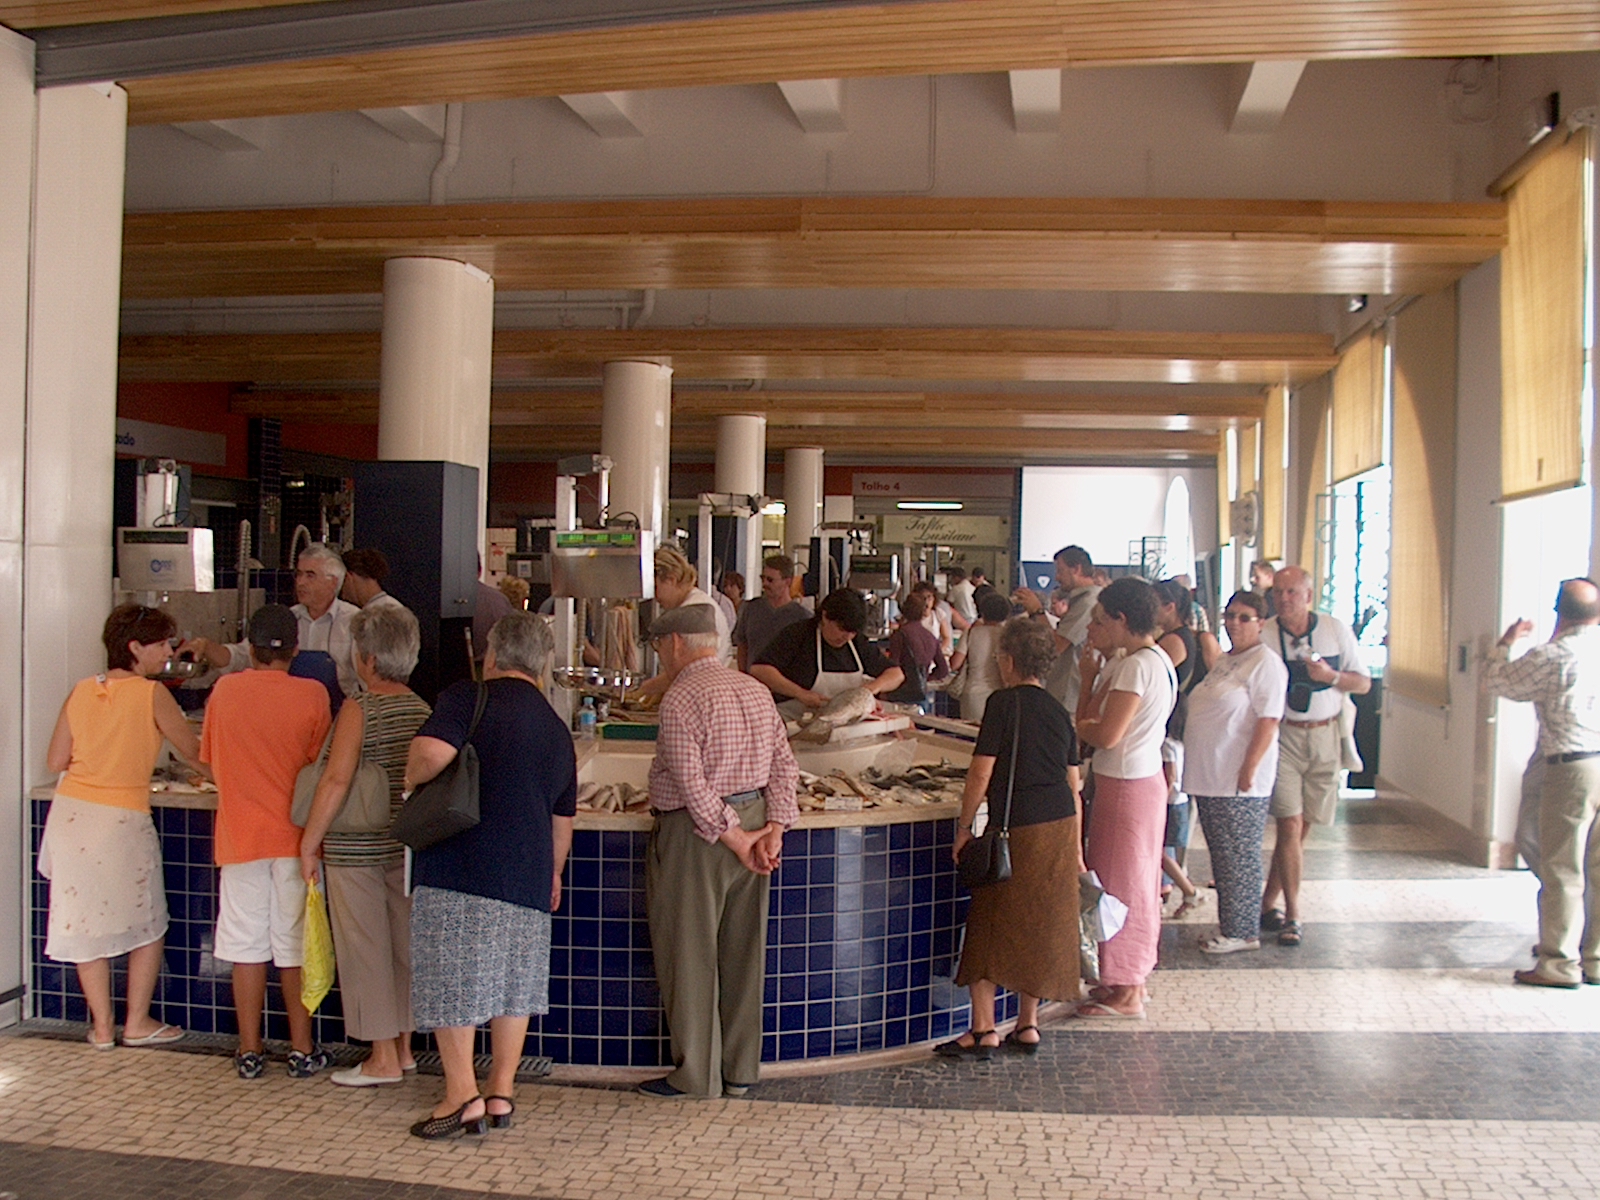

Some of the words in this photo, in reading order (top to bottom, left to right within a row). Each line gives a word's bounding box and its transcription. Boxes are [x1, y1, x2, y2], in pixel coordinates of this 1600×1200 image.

[861, 482, 890, 491] Talho
[893, 482, 900, 491] 4
[914, 529, 977, 542] Lusitano
